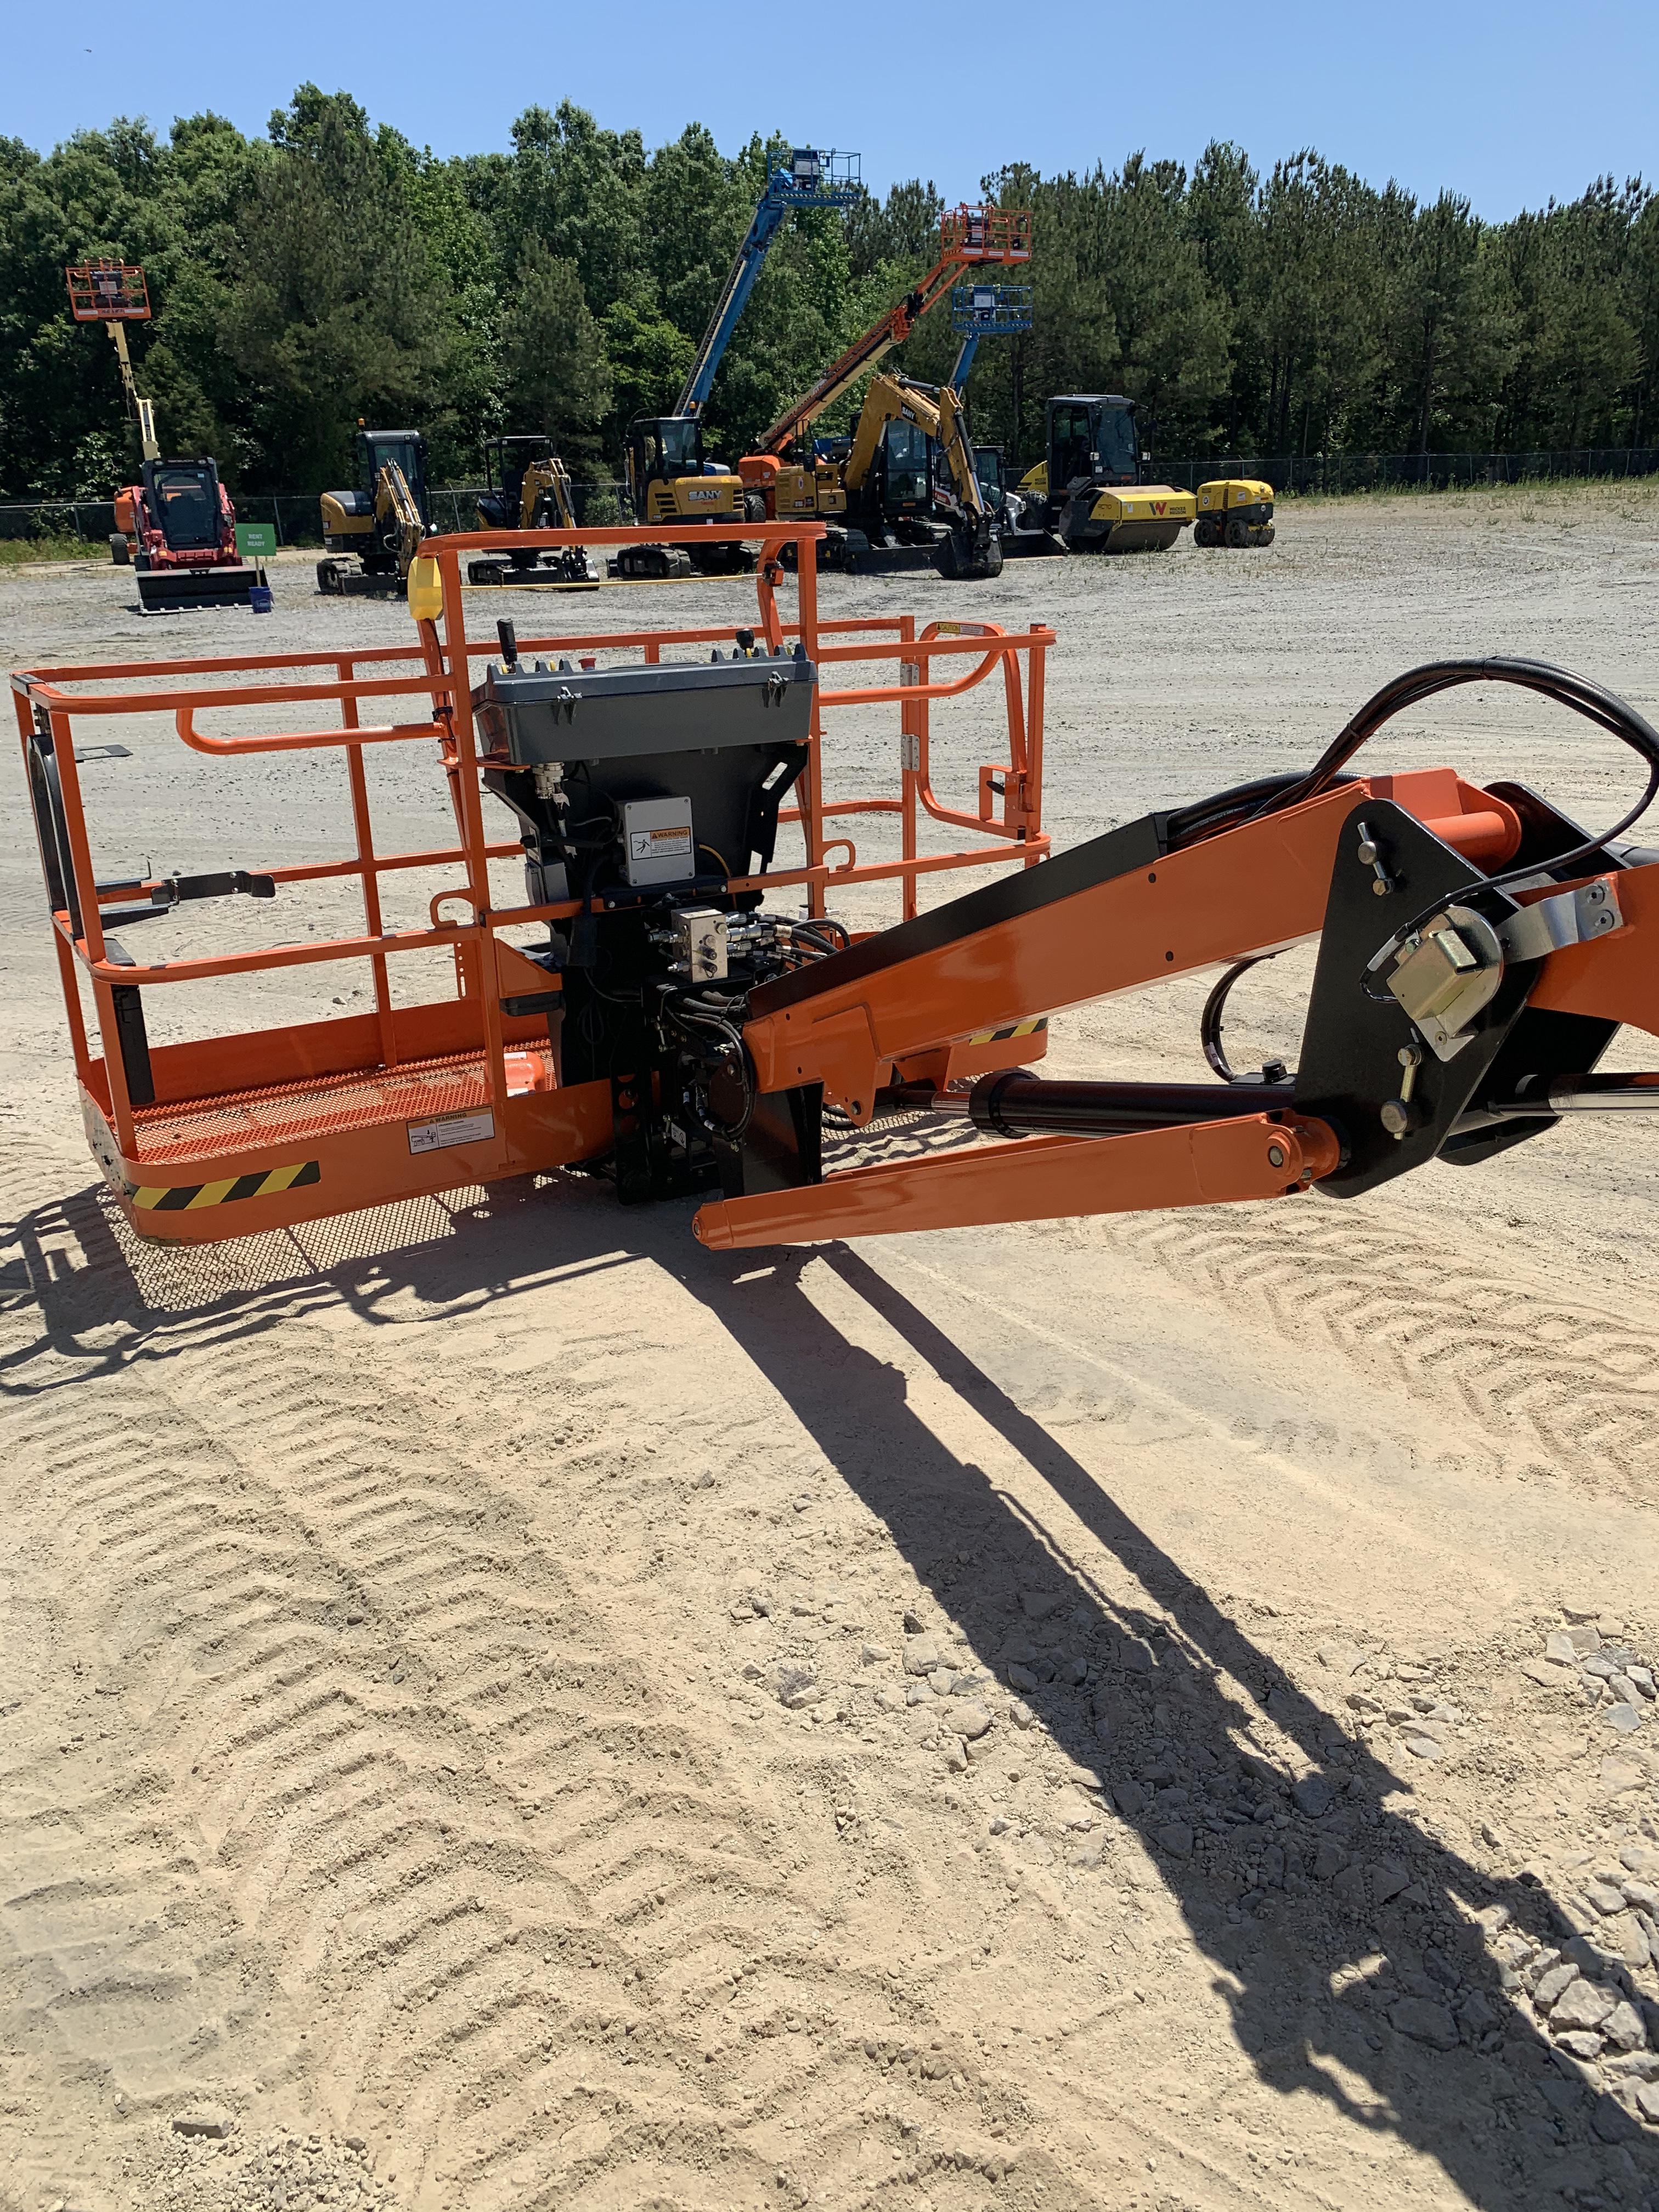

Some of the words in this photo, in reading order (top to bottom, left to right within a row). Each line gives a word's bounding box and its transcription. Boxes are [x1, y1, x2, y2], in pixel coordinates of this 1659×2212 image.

[902, 407, 915, 420] SANY
[689, 490, 722, 501] SANY
[436, 1113, 467, 1121] WARNING
